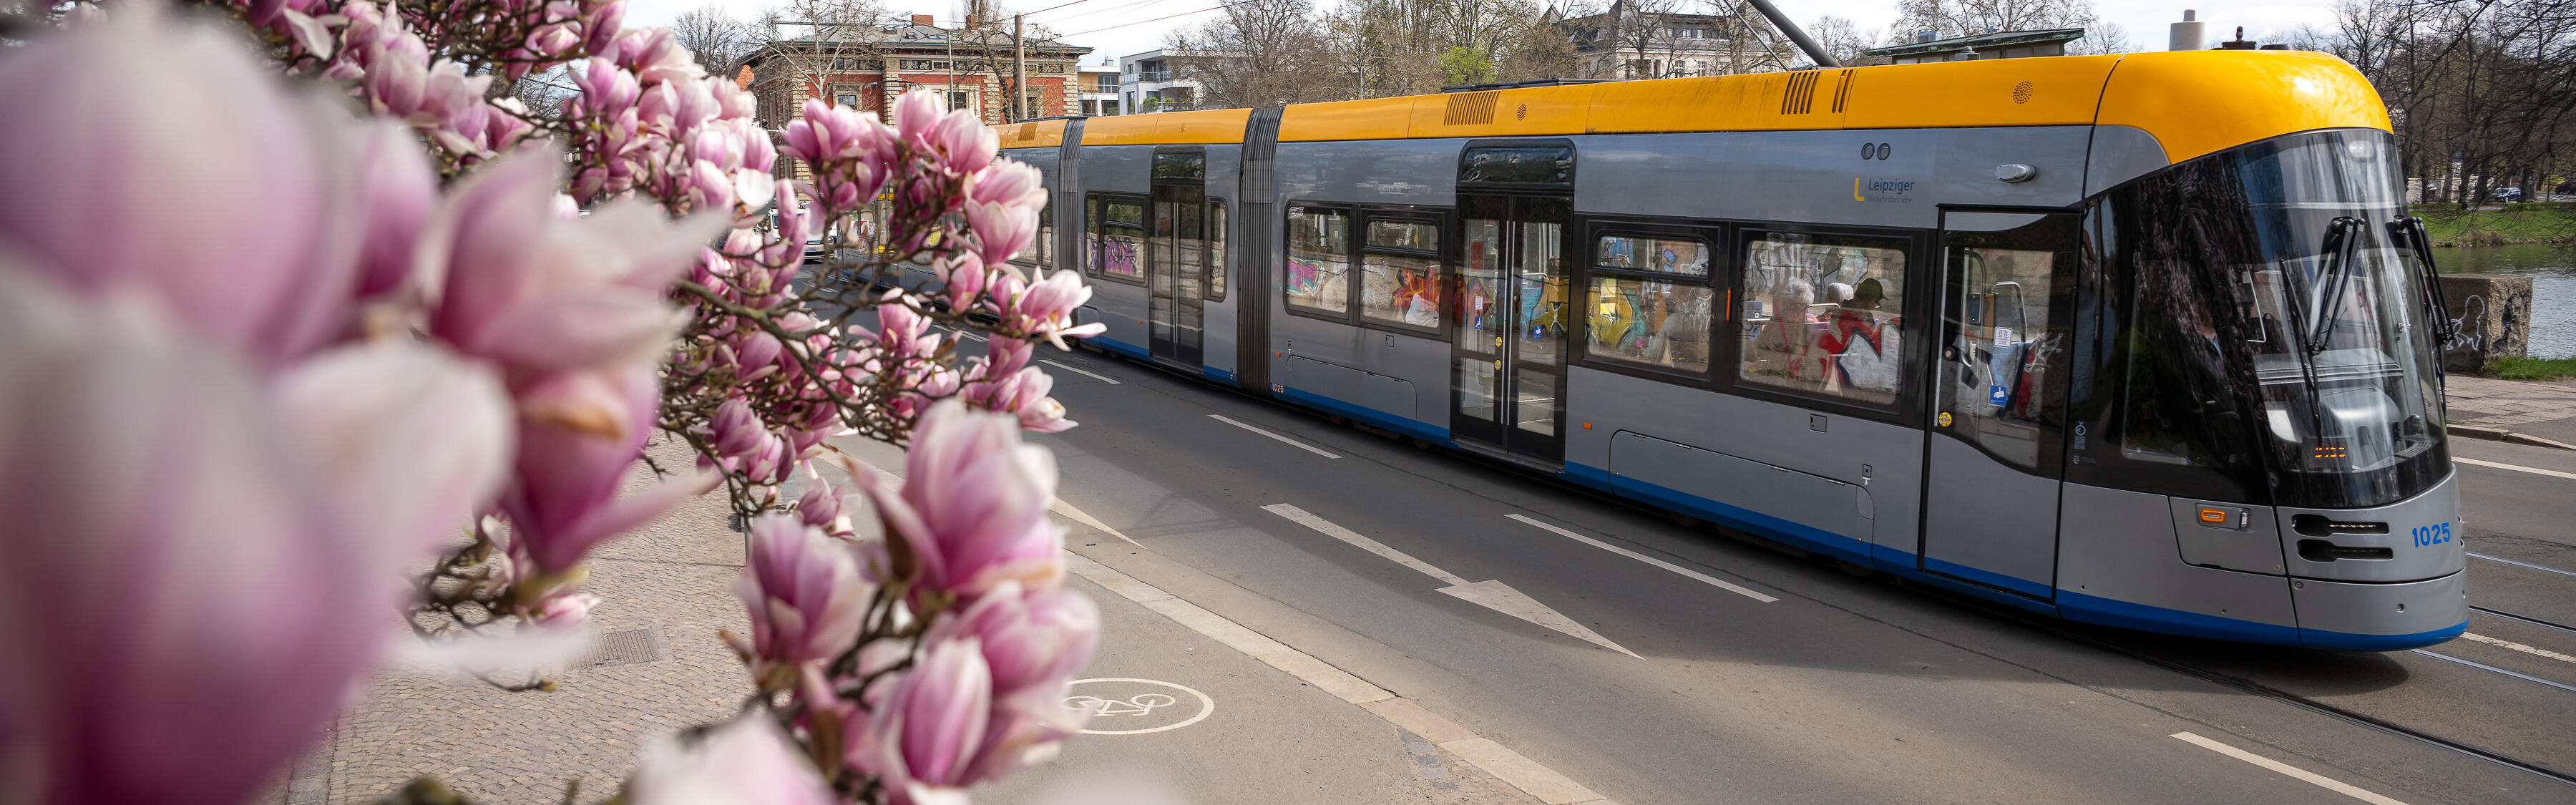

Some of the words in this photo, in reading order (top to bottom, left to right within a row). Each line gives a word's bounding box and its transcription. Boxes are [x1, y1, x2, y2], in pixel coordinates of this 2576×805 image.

[1868, 177, 1916, 195] Leipziger
[1272, 383, 1284, 394] 1025
[2411, 522, 2451, 547] 1025
